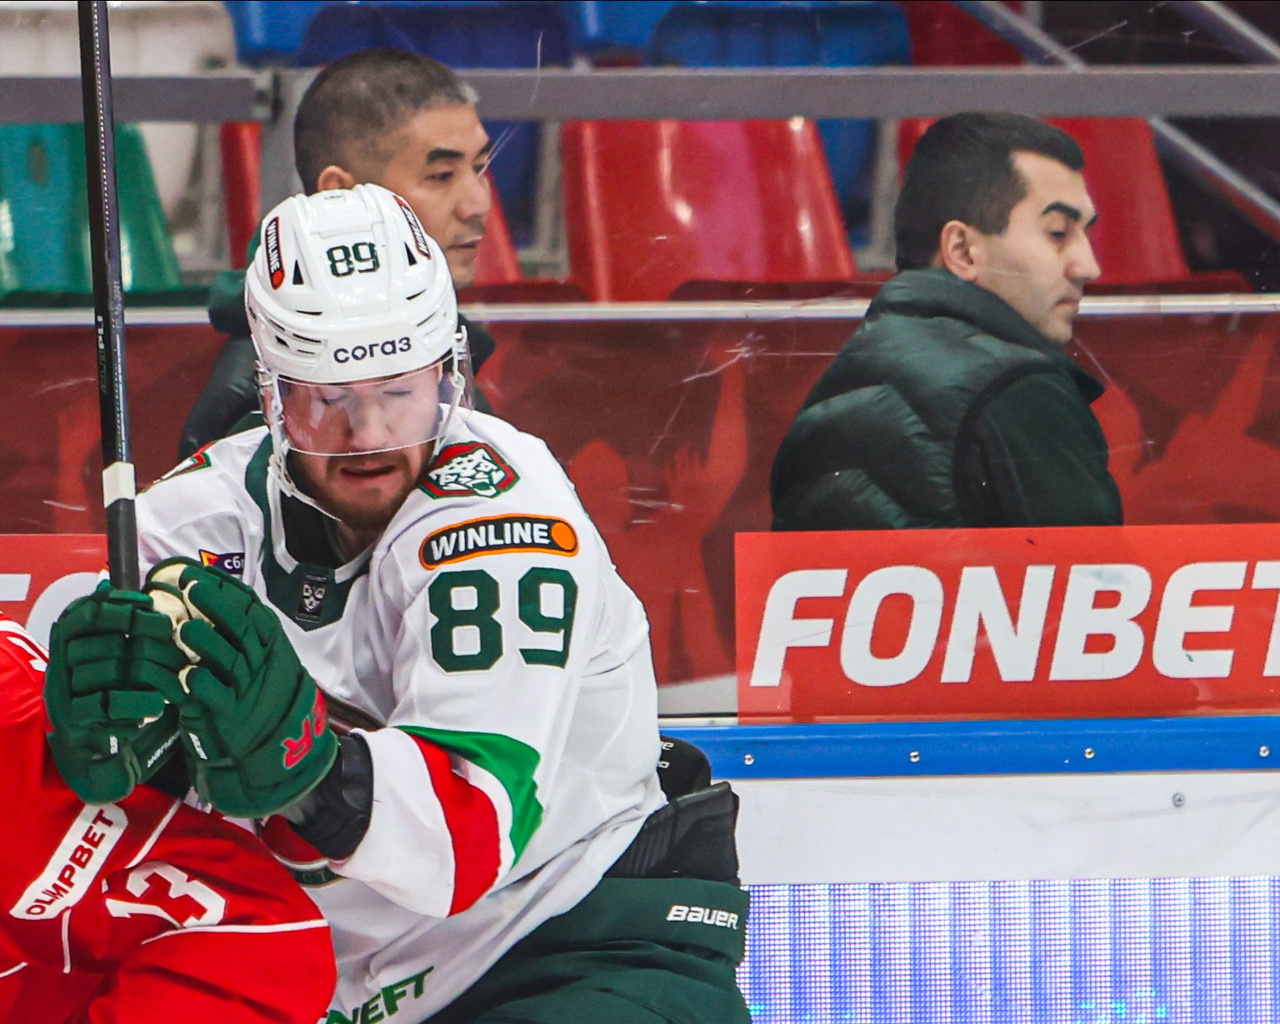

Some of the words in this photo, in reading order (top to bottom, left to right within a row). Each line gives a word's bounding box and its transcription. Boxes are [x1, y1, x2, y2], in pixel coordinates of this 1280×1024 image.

[266, 221, 281, 273] WINLINE
[326, 241, 380, 277] 89
[333, 336, 412, 363] согаз
[431, 522, 551, 561] WINLINE
[428, 566, 579, 673] 89
[749, 560, 1280, 687] FONBE
